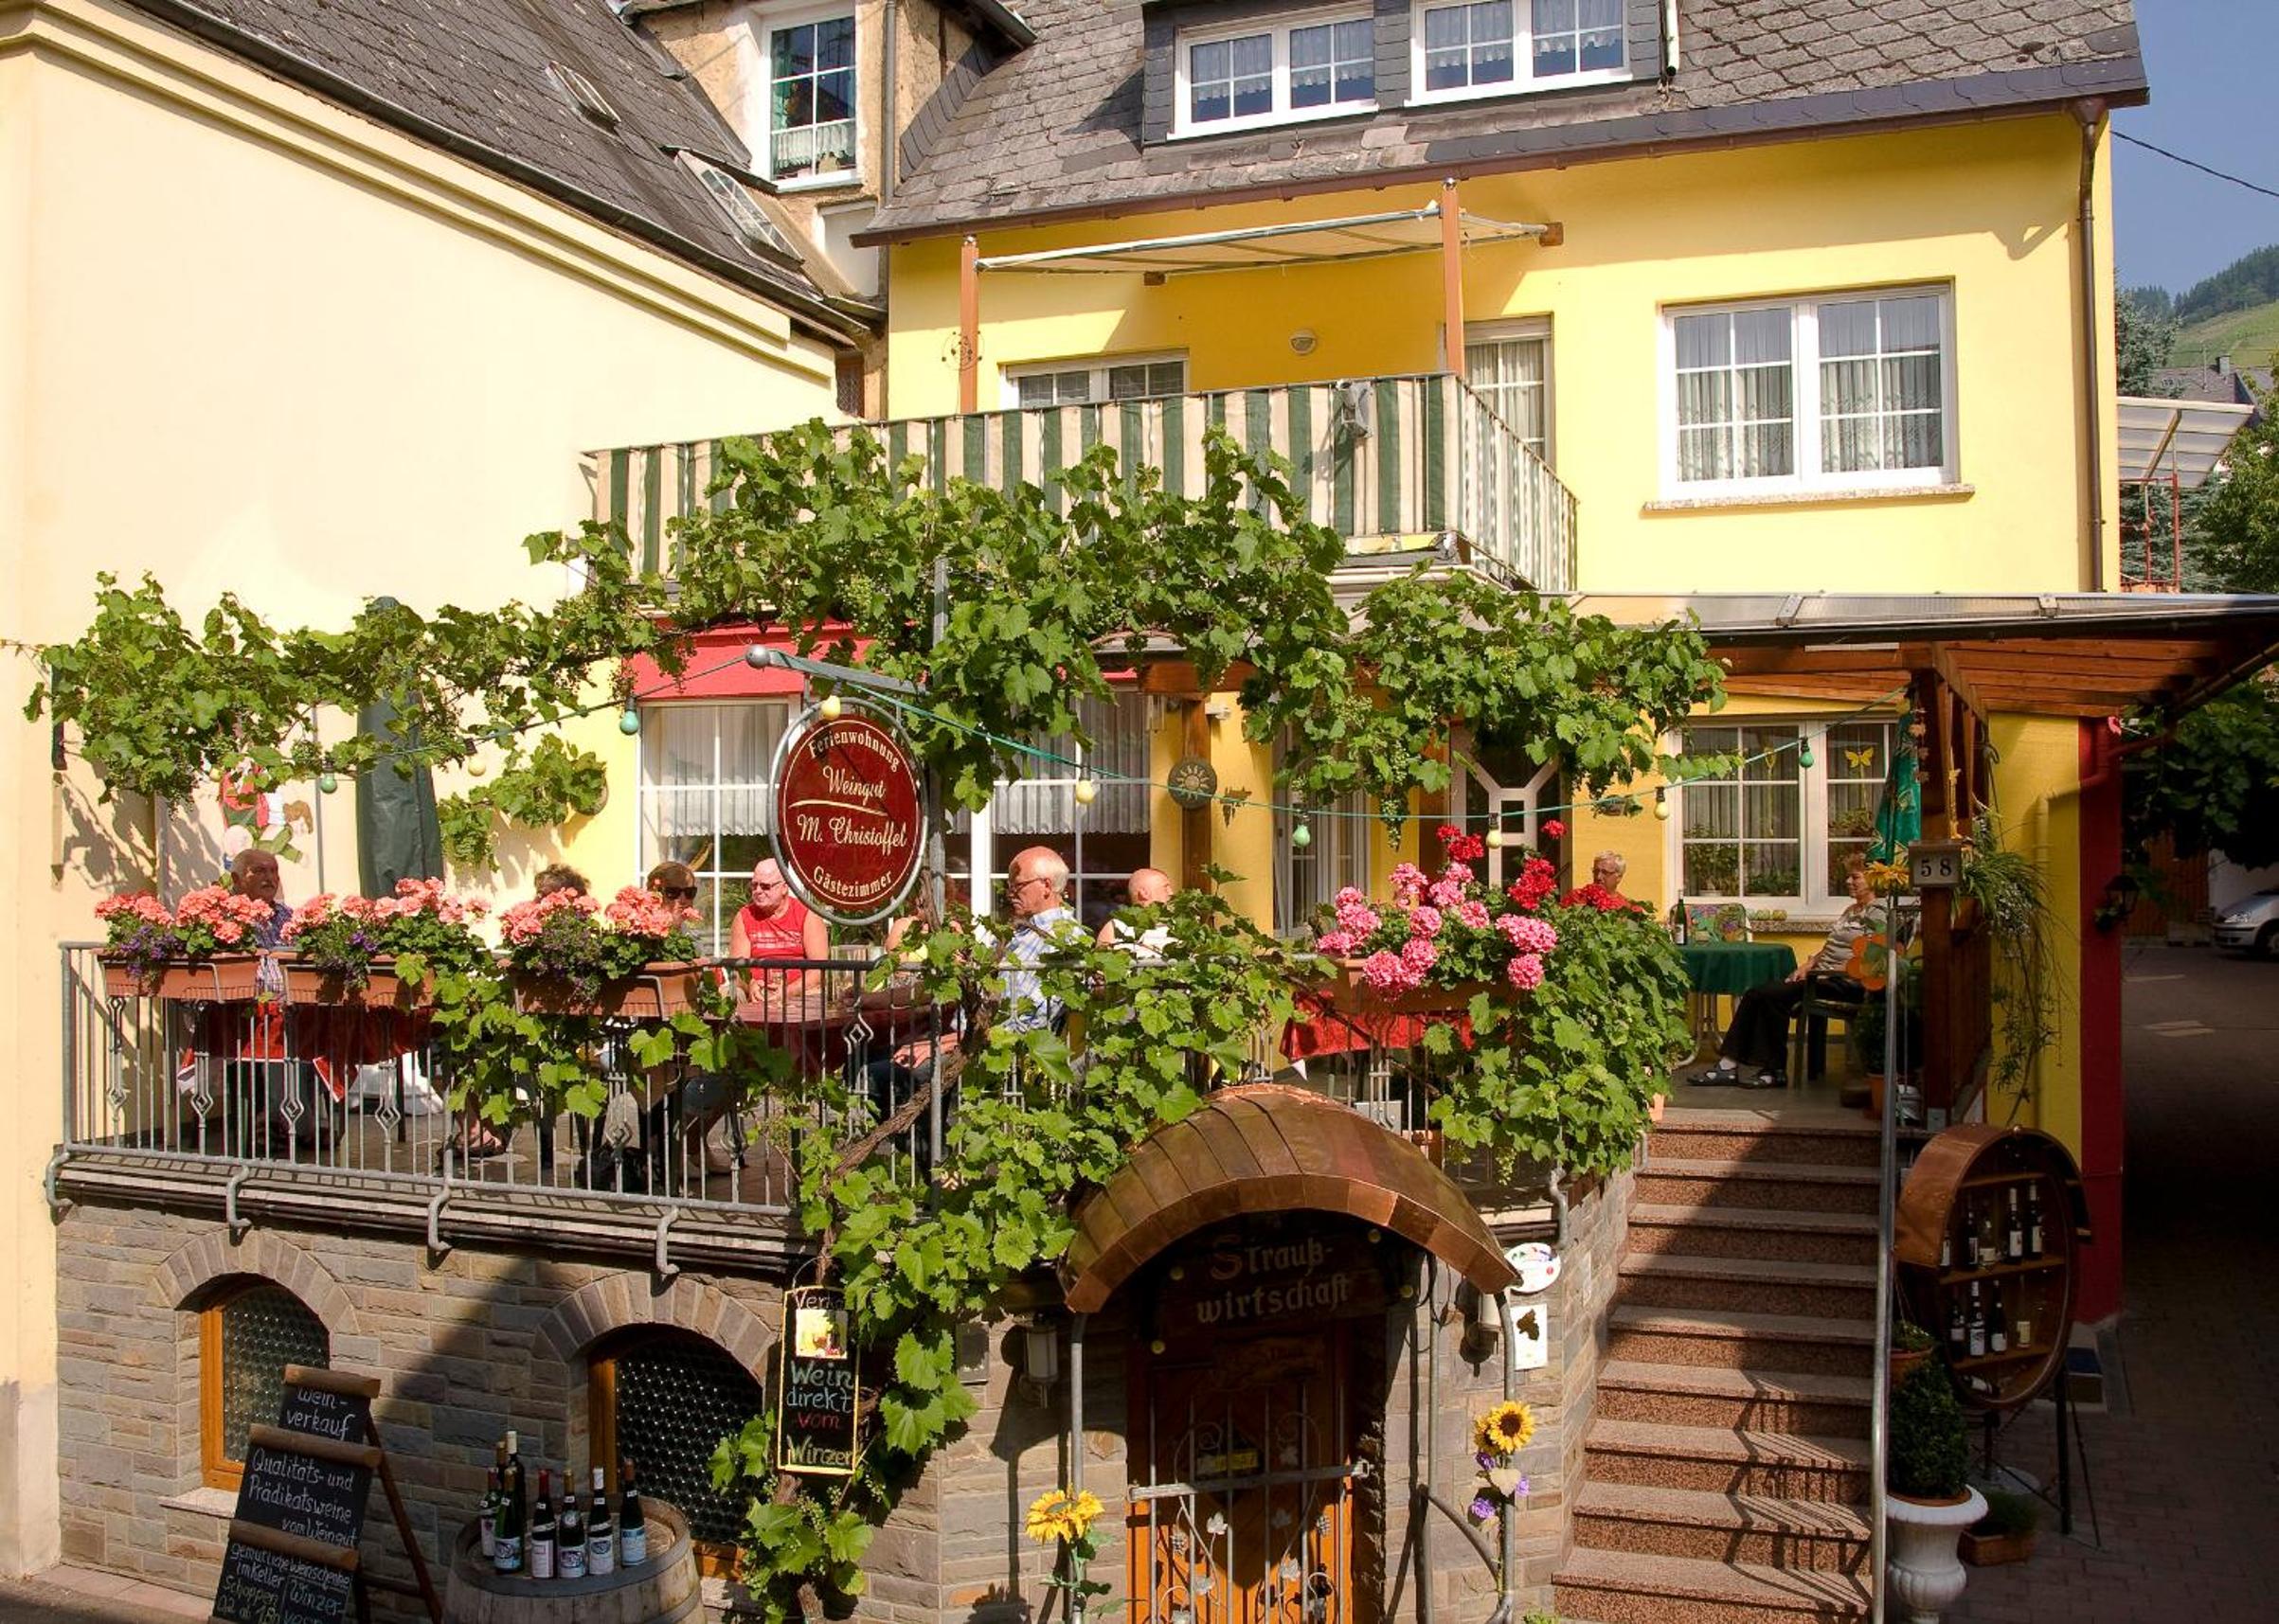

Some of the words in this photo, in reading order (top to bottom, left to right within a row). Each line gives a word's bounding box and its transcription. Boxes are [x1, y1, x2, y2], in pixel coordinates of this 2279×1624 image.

[808, 730, 900, 773] Ferienwohnung
[822, 765, 887, 806] Weingut
[797, 814, 823, 843] M.
[829, 815, 907, 856] Christoffel
[813, 866, 892, 898] Gästezimmer
[1196, 1272, 1350, 1324] wirtschaft
[790, 1359, 853, 1389] Wein
[786, 1386, 853, 1414] direkt
[798, 1412, 840, 1430] vom
[786, 1434, 853, 1466] Winzer
